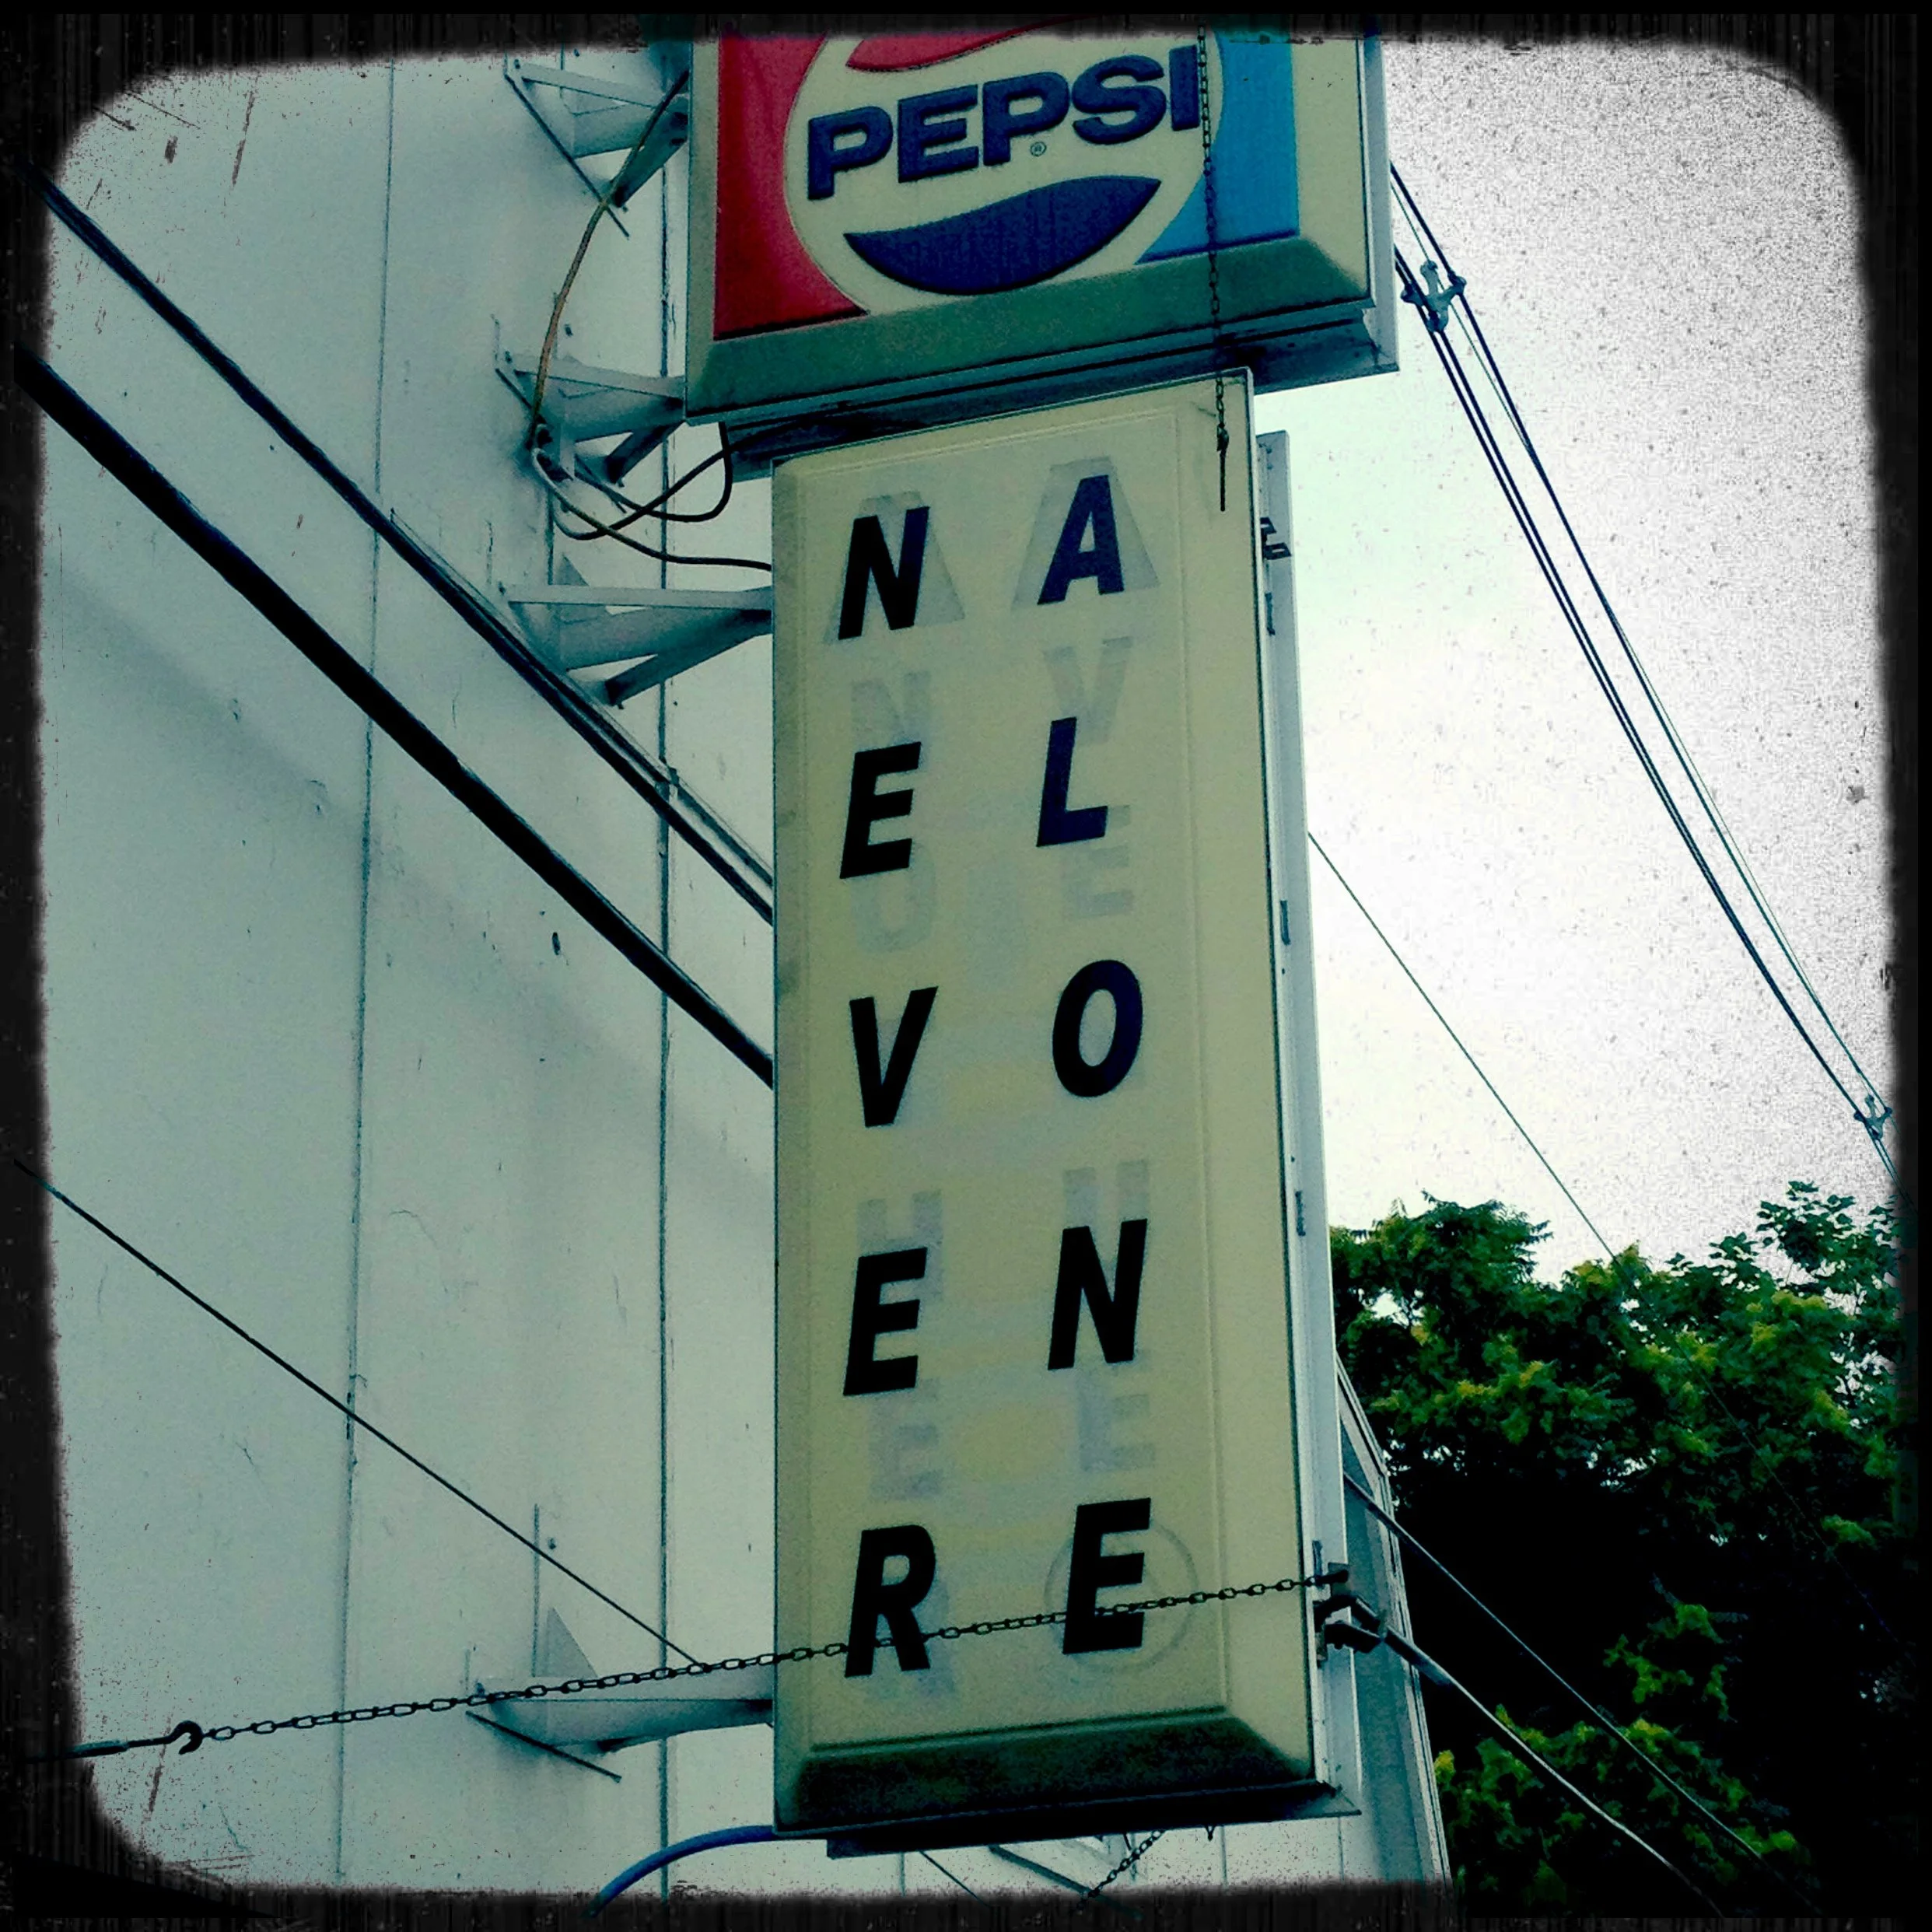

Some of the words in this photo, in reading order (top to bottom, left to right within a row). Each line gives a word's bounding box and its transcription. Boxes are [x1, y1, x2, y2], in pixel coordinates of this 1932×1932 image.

[807, 44, 1202, 201] PEPSI
[837, 506, 939, 1678] NEVER
[1035, 474, 1152, 1655] ALONE
